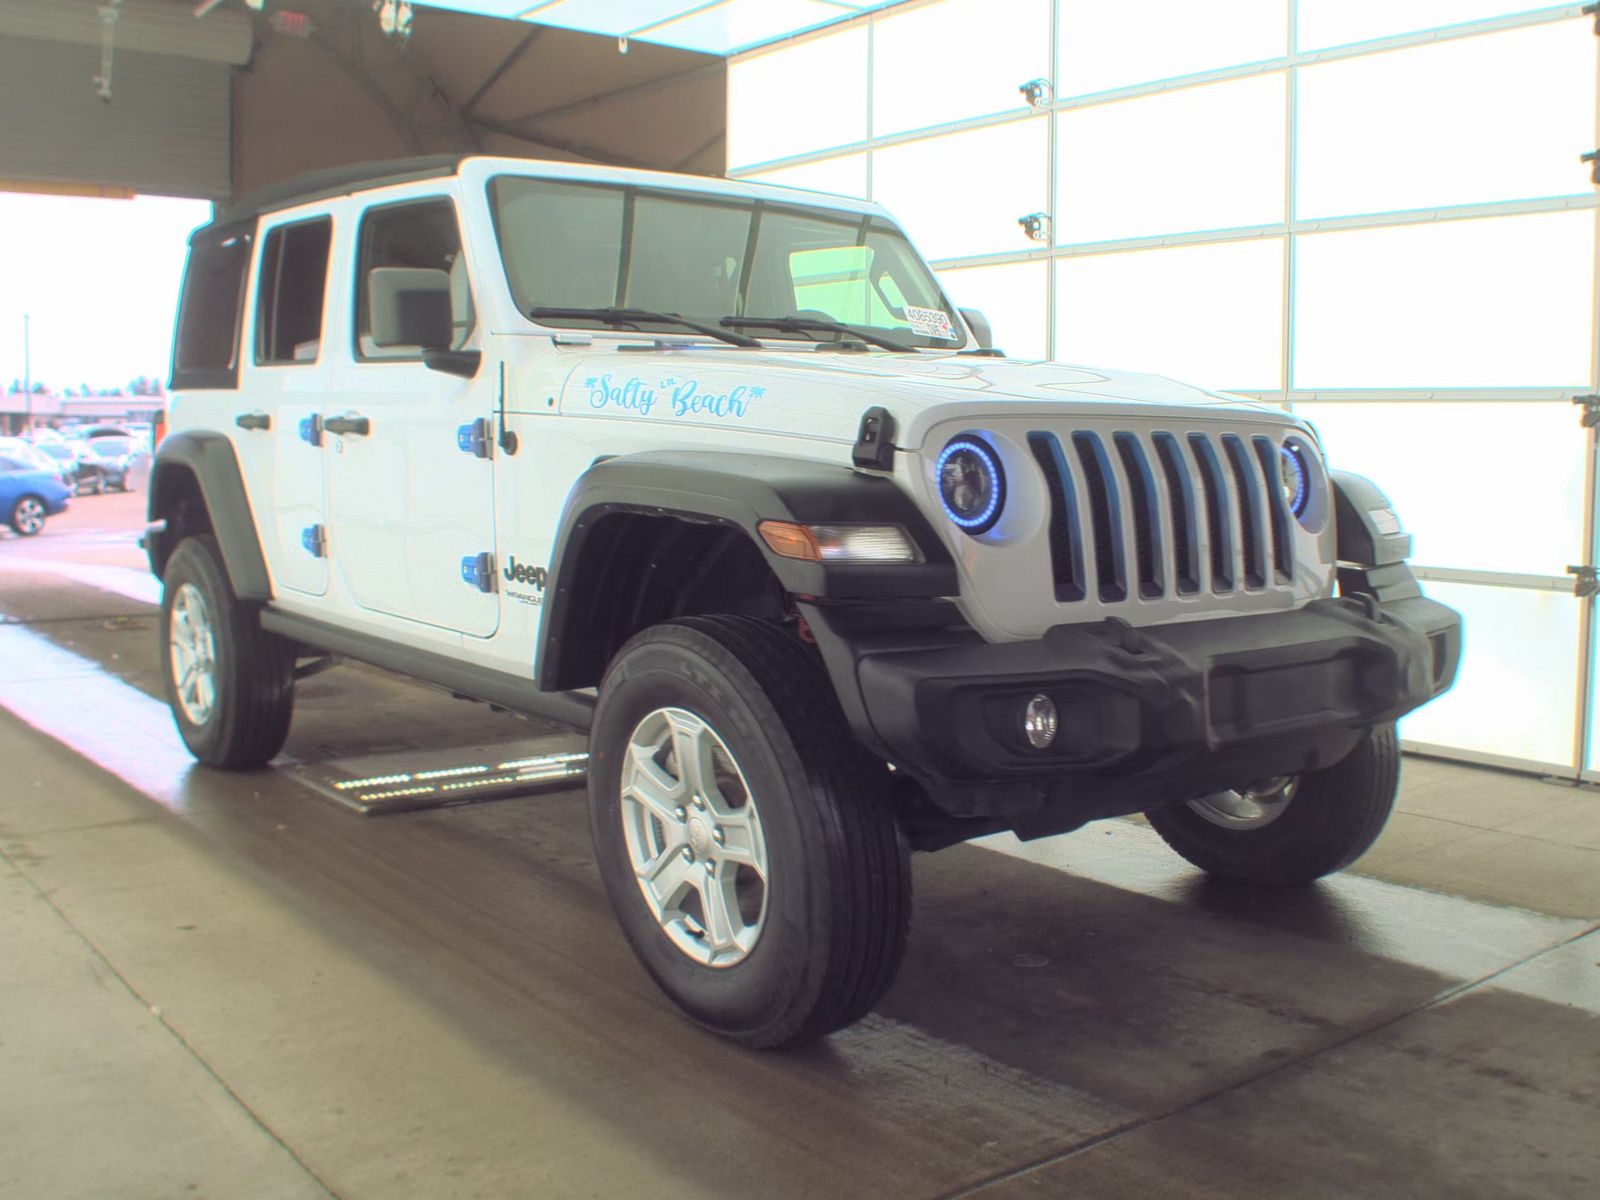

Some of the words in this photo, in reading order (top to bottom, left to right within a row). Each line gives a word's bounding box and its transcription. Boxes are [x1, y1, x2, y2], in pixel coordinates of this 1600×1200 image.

[590, 374, 657, 416] Salty
[671, 380, 749, 418] Beach
[503, 555, 547, 592] Jeep
